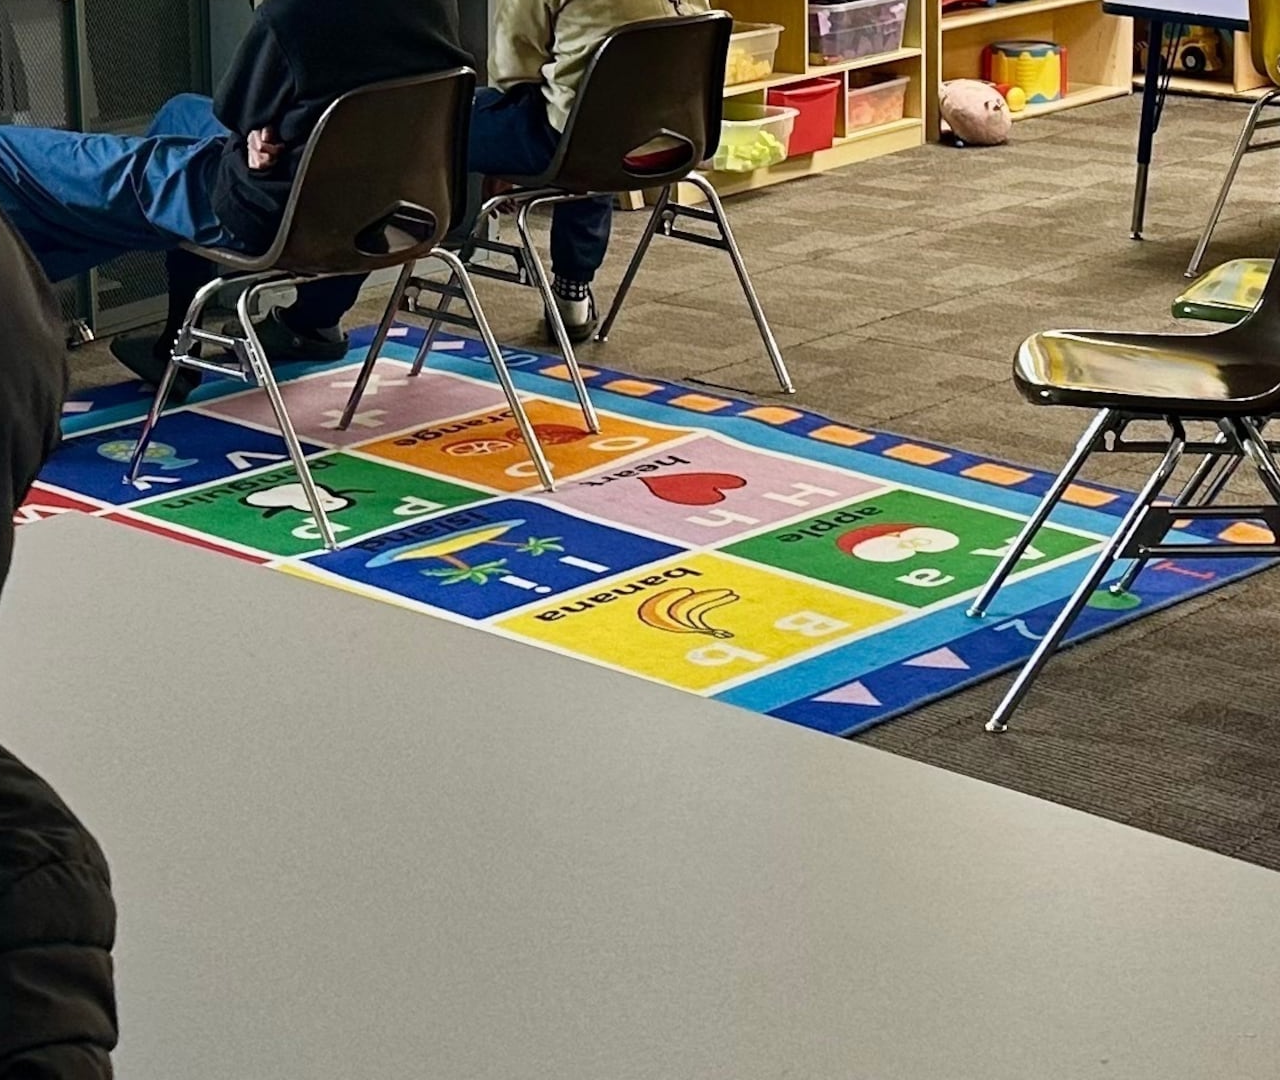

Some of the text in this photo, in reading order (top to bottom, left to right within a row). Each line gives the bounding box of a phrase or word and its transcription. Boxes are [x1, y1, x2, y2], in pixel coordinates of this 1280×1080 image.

[161, 460, 336, 511] penguin
[578, 455, 690, 488] heart
[762, 482, 841, 507] H
[686, 508, 760, 530] h
[776, 505, 883, 543] apple
[895, 567, 955, 587] a
[534, 566, 704, 621] banana
[773, 609, 852, 638] B
[686, 641, 768, 667] b
